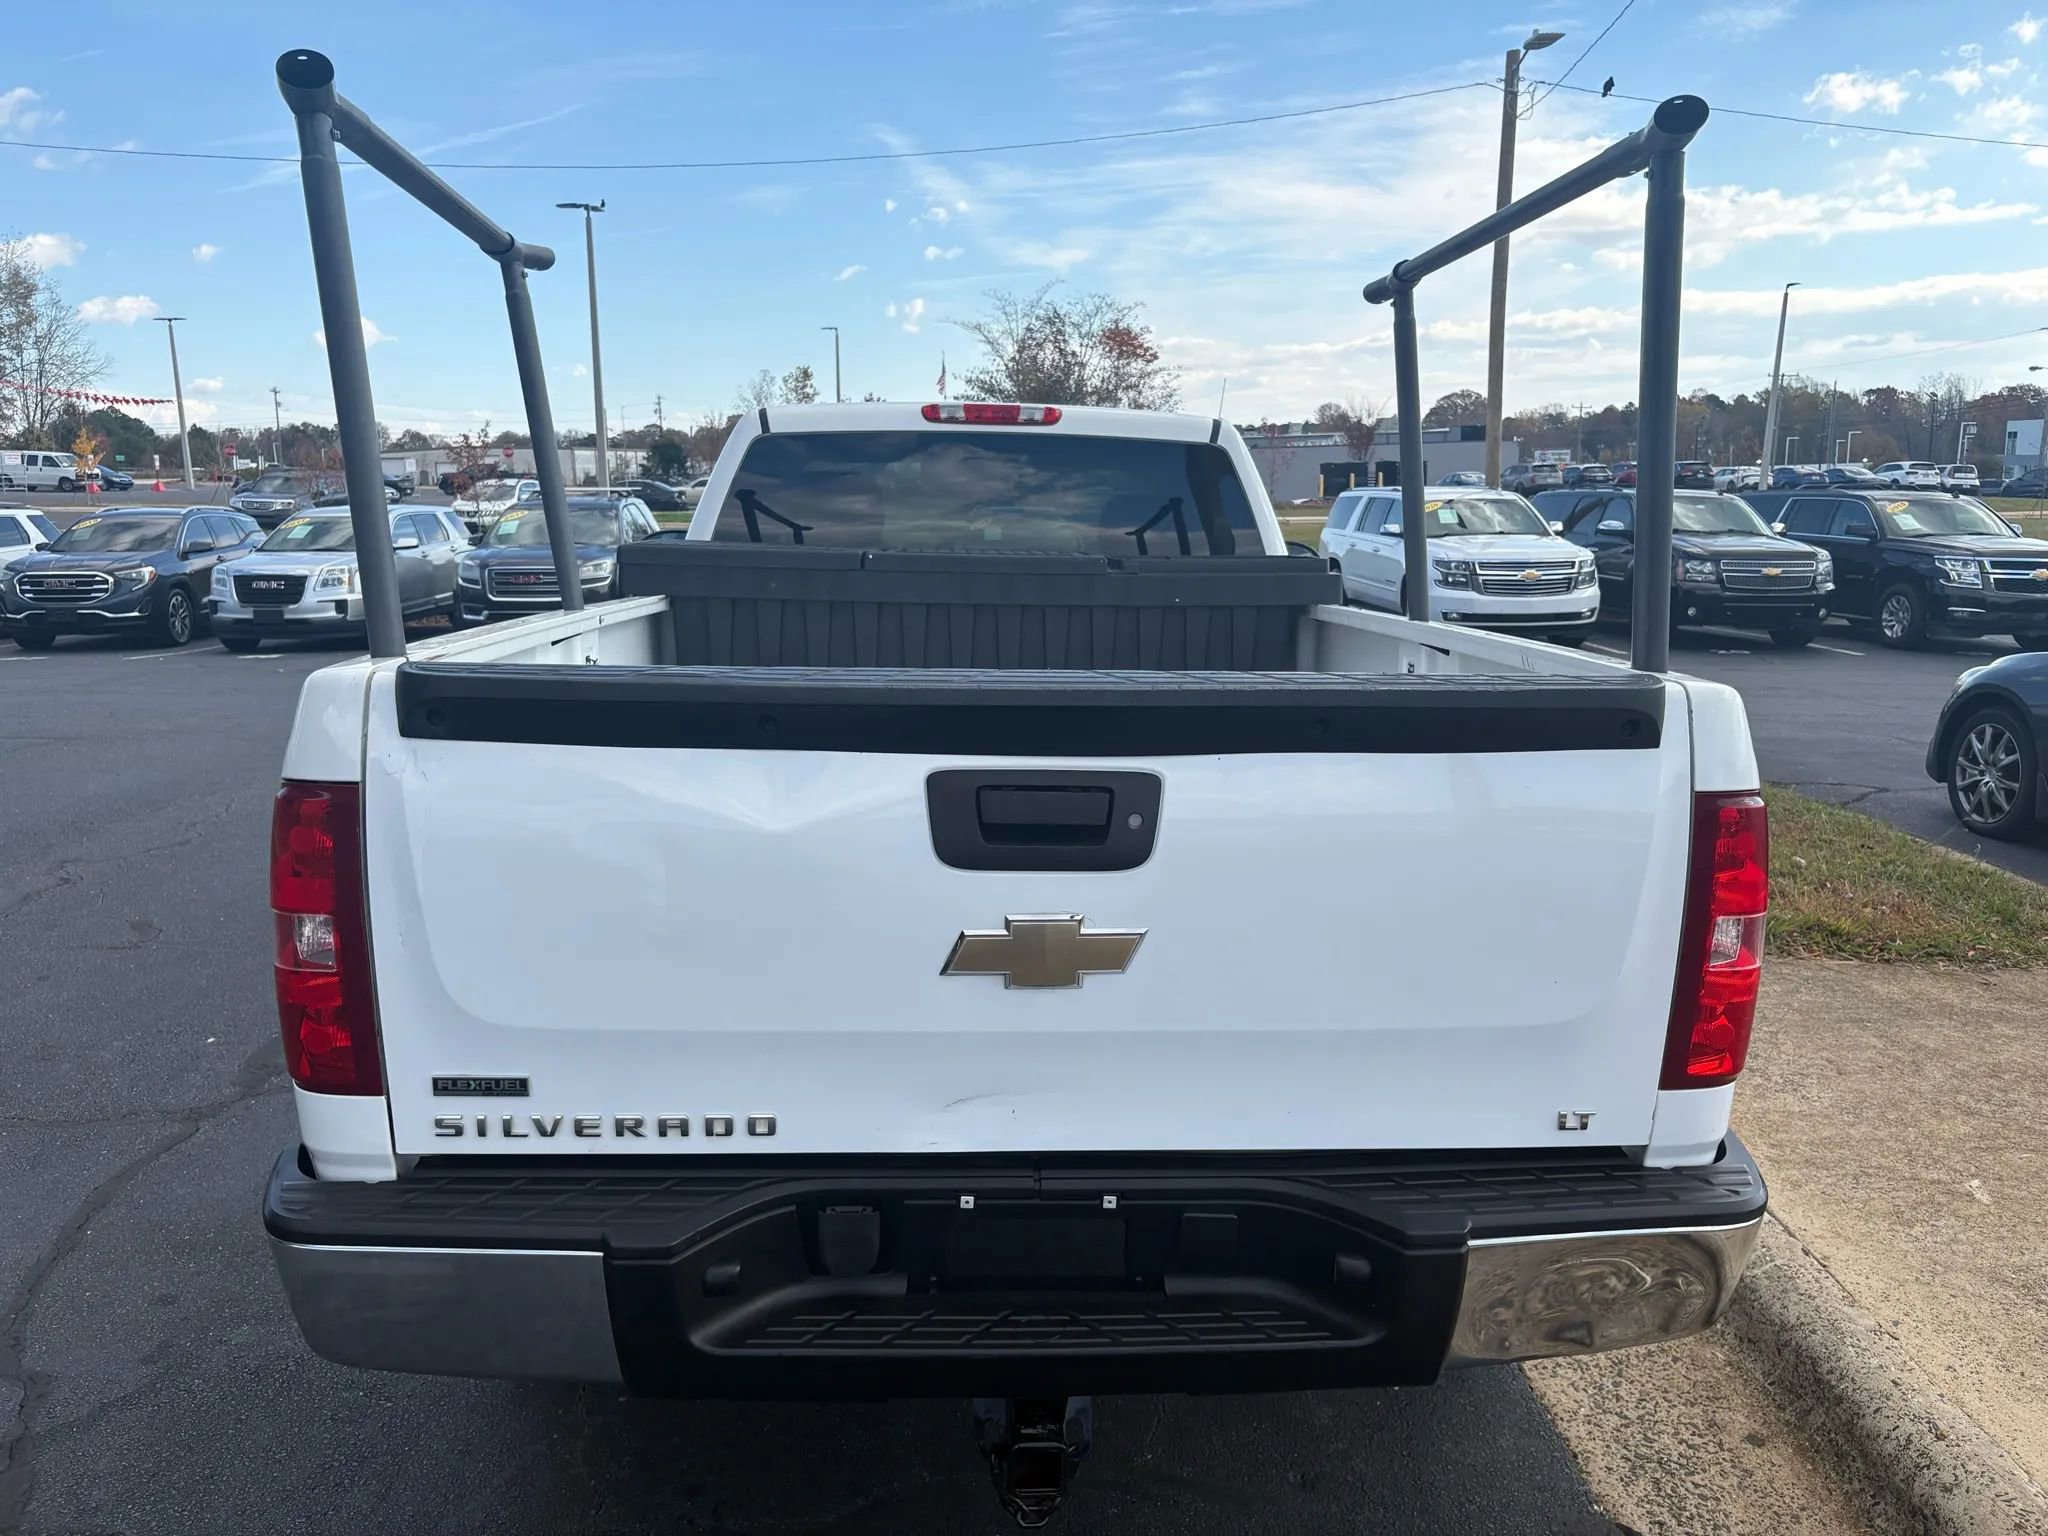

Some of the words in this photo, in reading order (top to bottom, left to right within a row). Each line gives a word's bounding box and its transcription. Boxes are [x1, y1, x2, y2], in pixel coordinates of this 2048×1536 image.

[43, 579, 77, 590] GMC
[251, 580, 285, 590] GMC
[437, 1079, 526, 1091] FLEXFUEL
[434, 1113, 777, 1138] SILVERADO
[1557, 1110, 1597, 1131] LT
